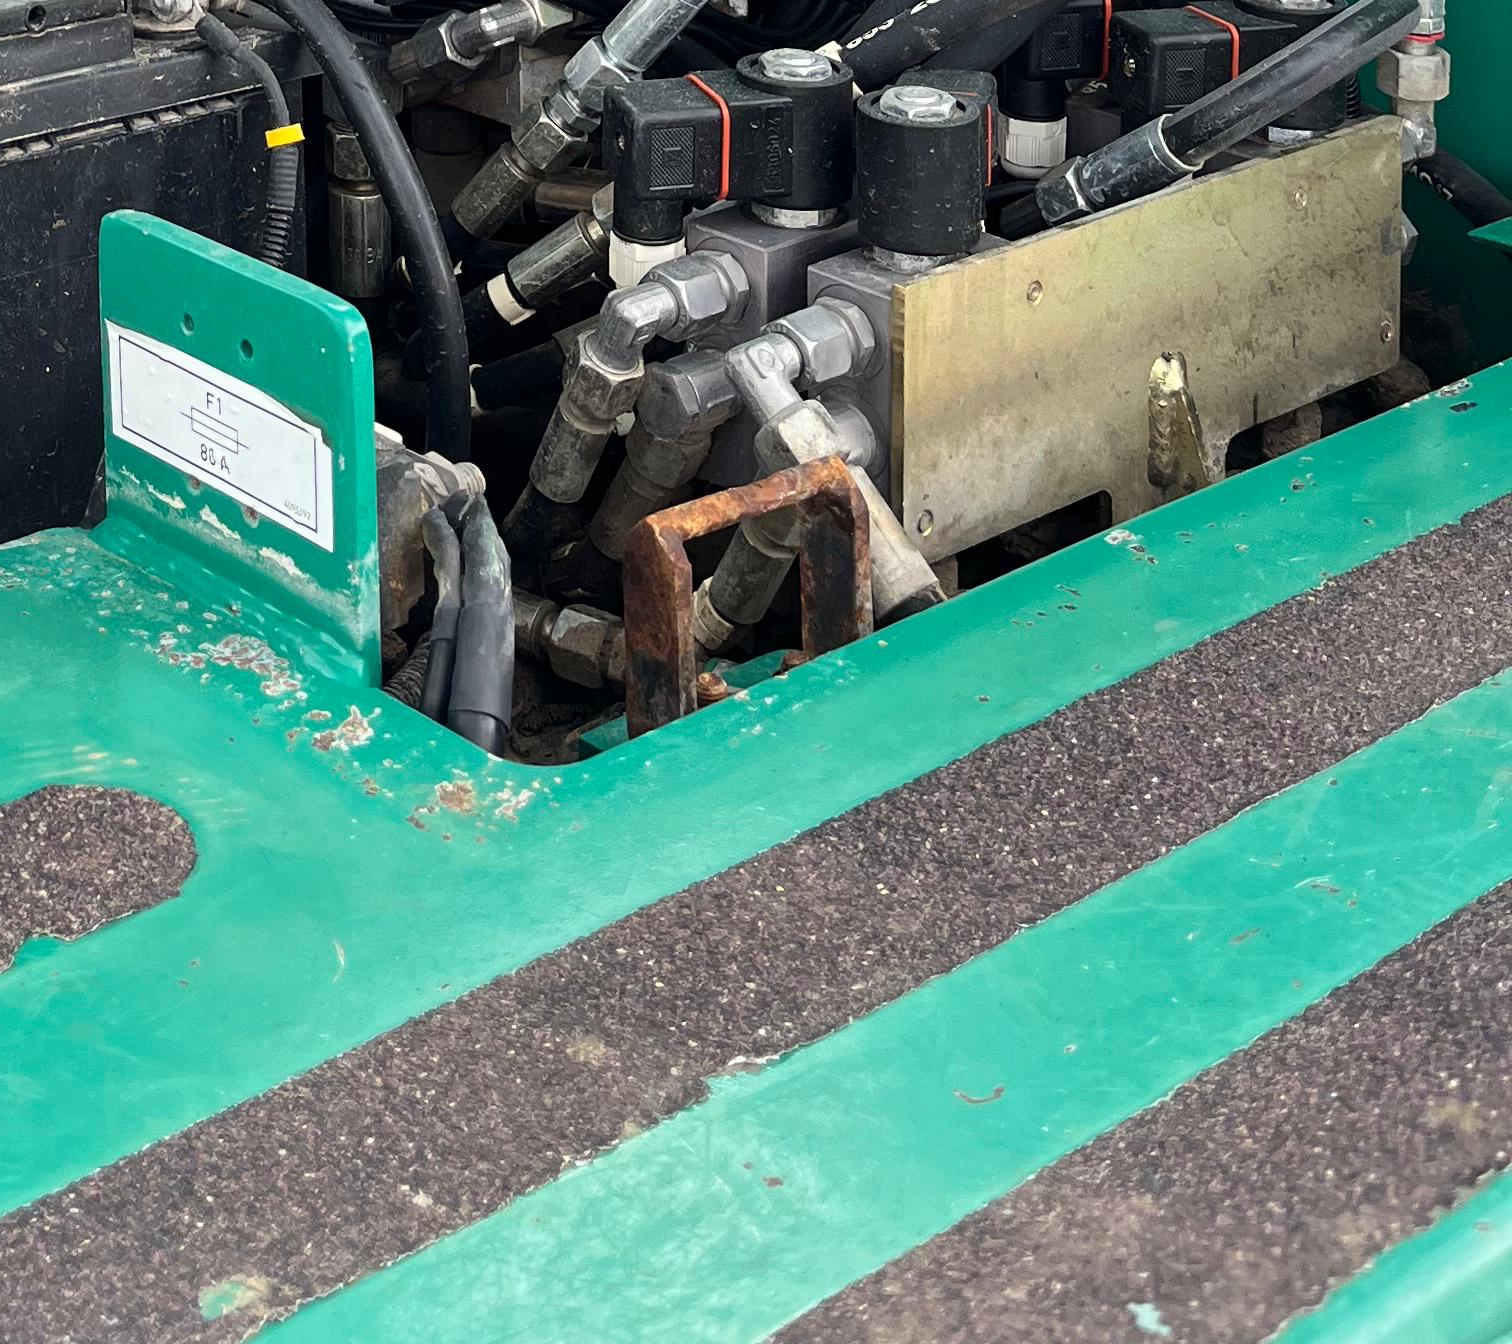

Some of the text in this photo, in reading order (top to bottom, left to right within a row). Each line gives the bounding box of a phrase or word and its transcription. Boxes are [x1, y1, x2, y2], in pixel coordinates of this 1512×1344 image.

[206, 391, 222, 416] F1
[199, 443, 231, 475] 80 A
